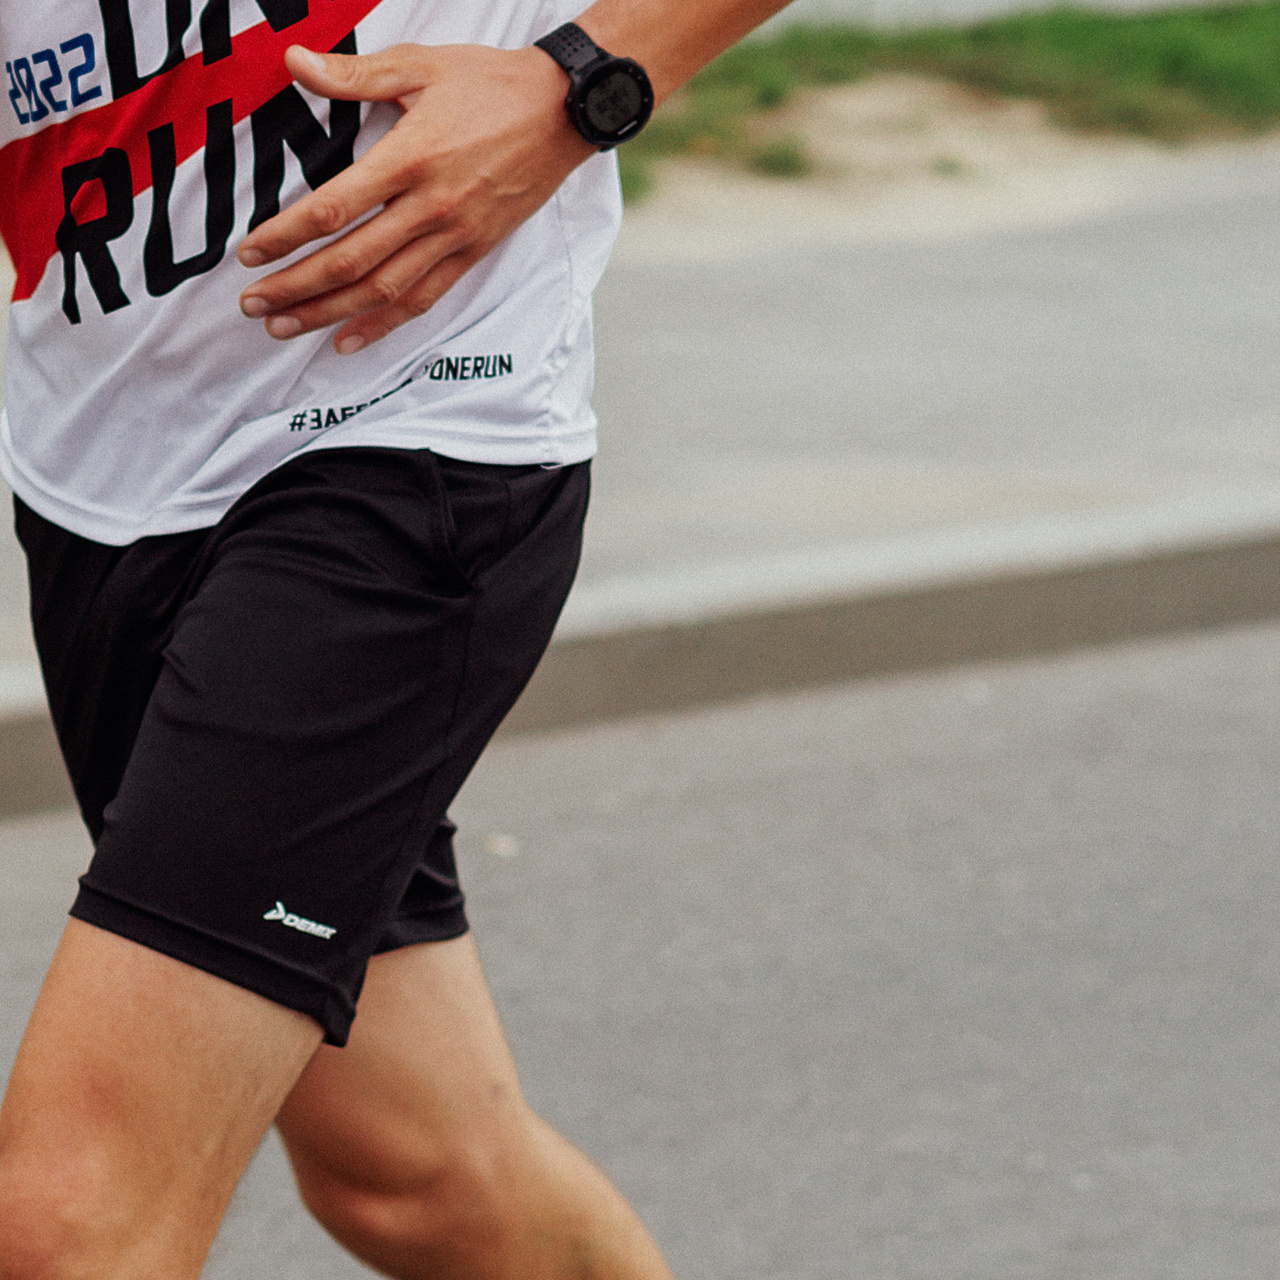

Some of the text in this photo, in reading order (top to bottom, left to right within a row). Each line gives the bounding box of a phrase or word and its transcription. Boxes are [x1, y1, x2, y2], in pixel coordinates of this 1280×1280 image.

[5, 32, 103, 125] 2022
[55, 27, 362, 325] RUN
[424, 353, 513, 381] ONERUN
